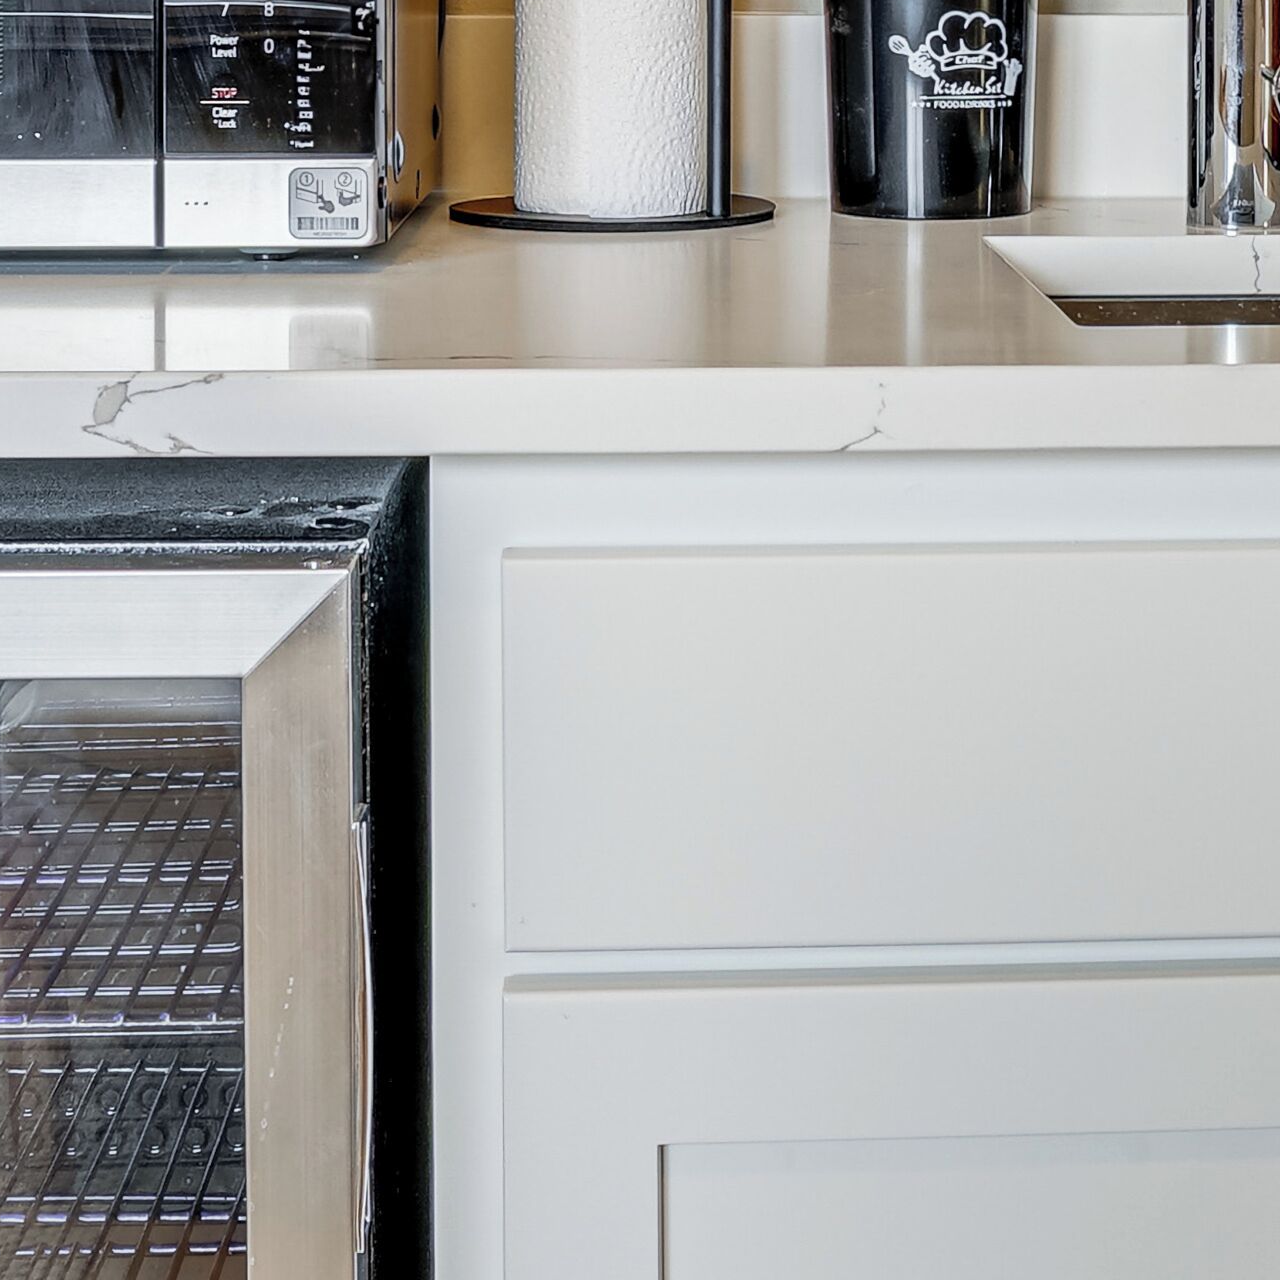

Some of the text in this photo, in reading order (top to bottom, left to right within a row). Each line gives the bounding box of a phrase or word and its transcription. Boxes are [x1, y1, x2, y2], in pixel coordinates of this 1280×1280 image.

[220, 1, 275, 17] 7 8
[209, 34, 239, 46] Power
[263, 38, 275, 54] 0
[211, 47, 237, 58] Level
[933, 76, 1002, 95] Kitchen Set
[211, 87, 237, 99] STOP
[211, 107, 238, 118] Clear
